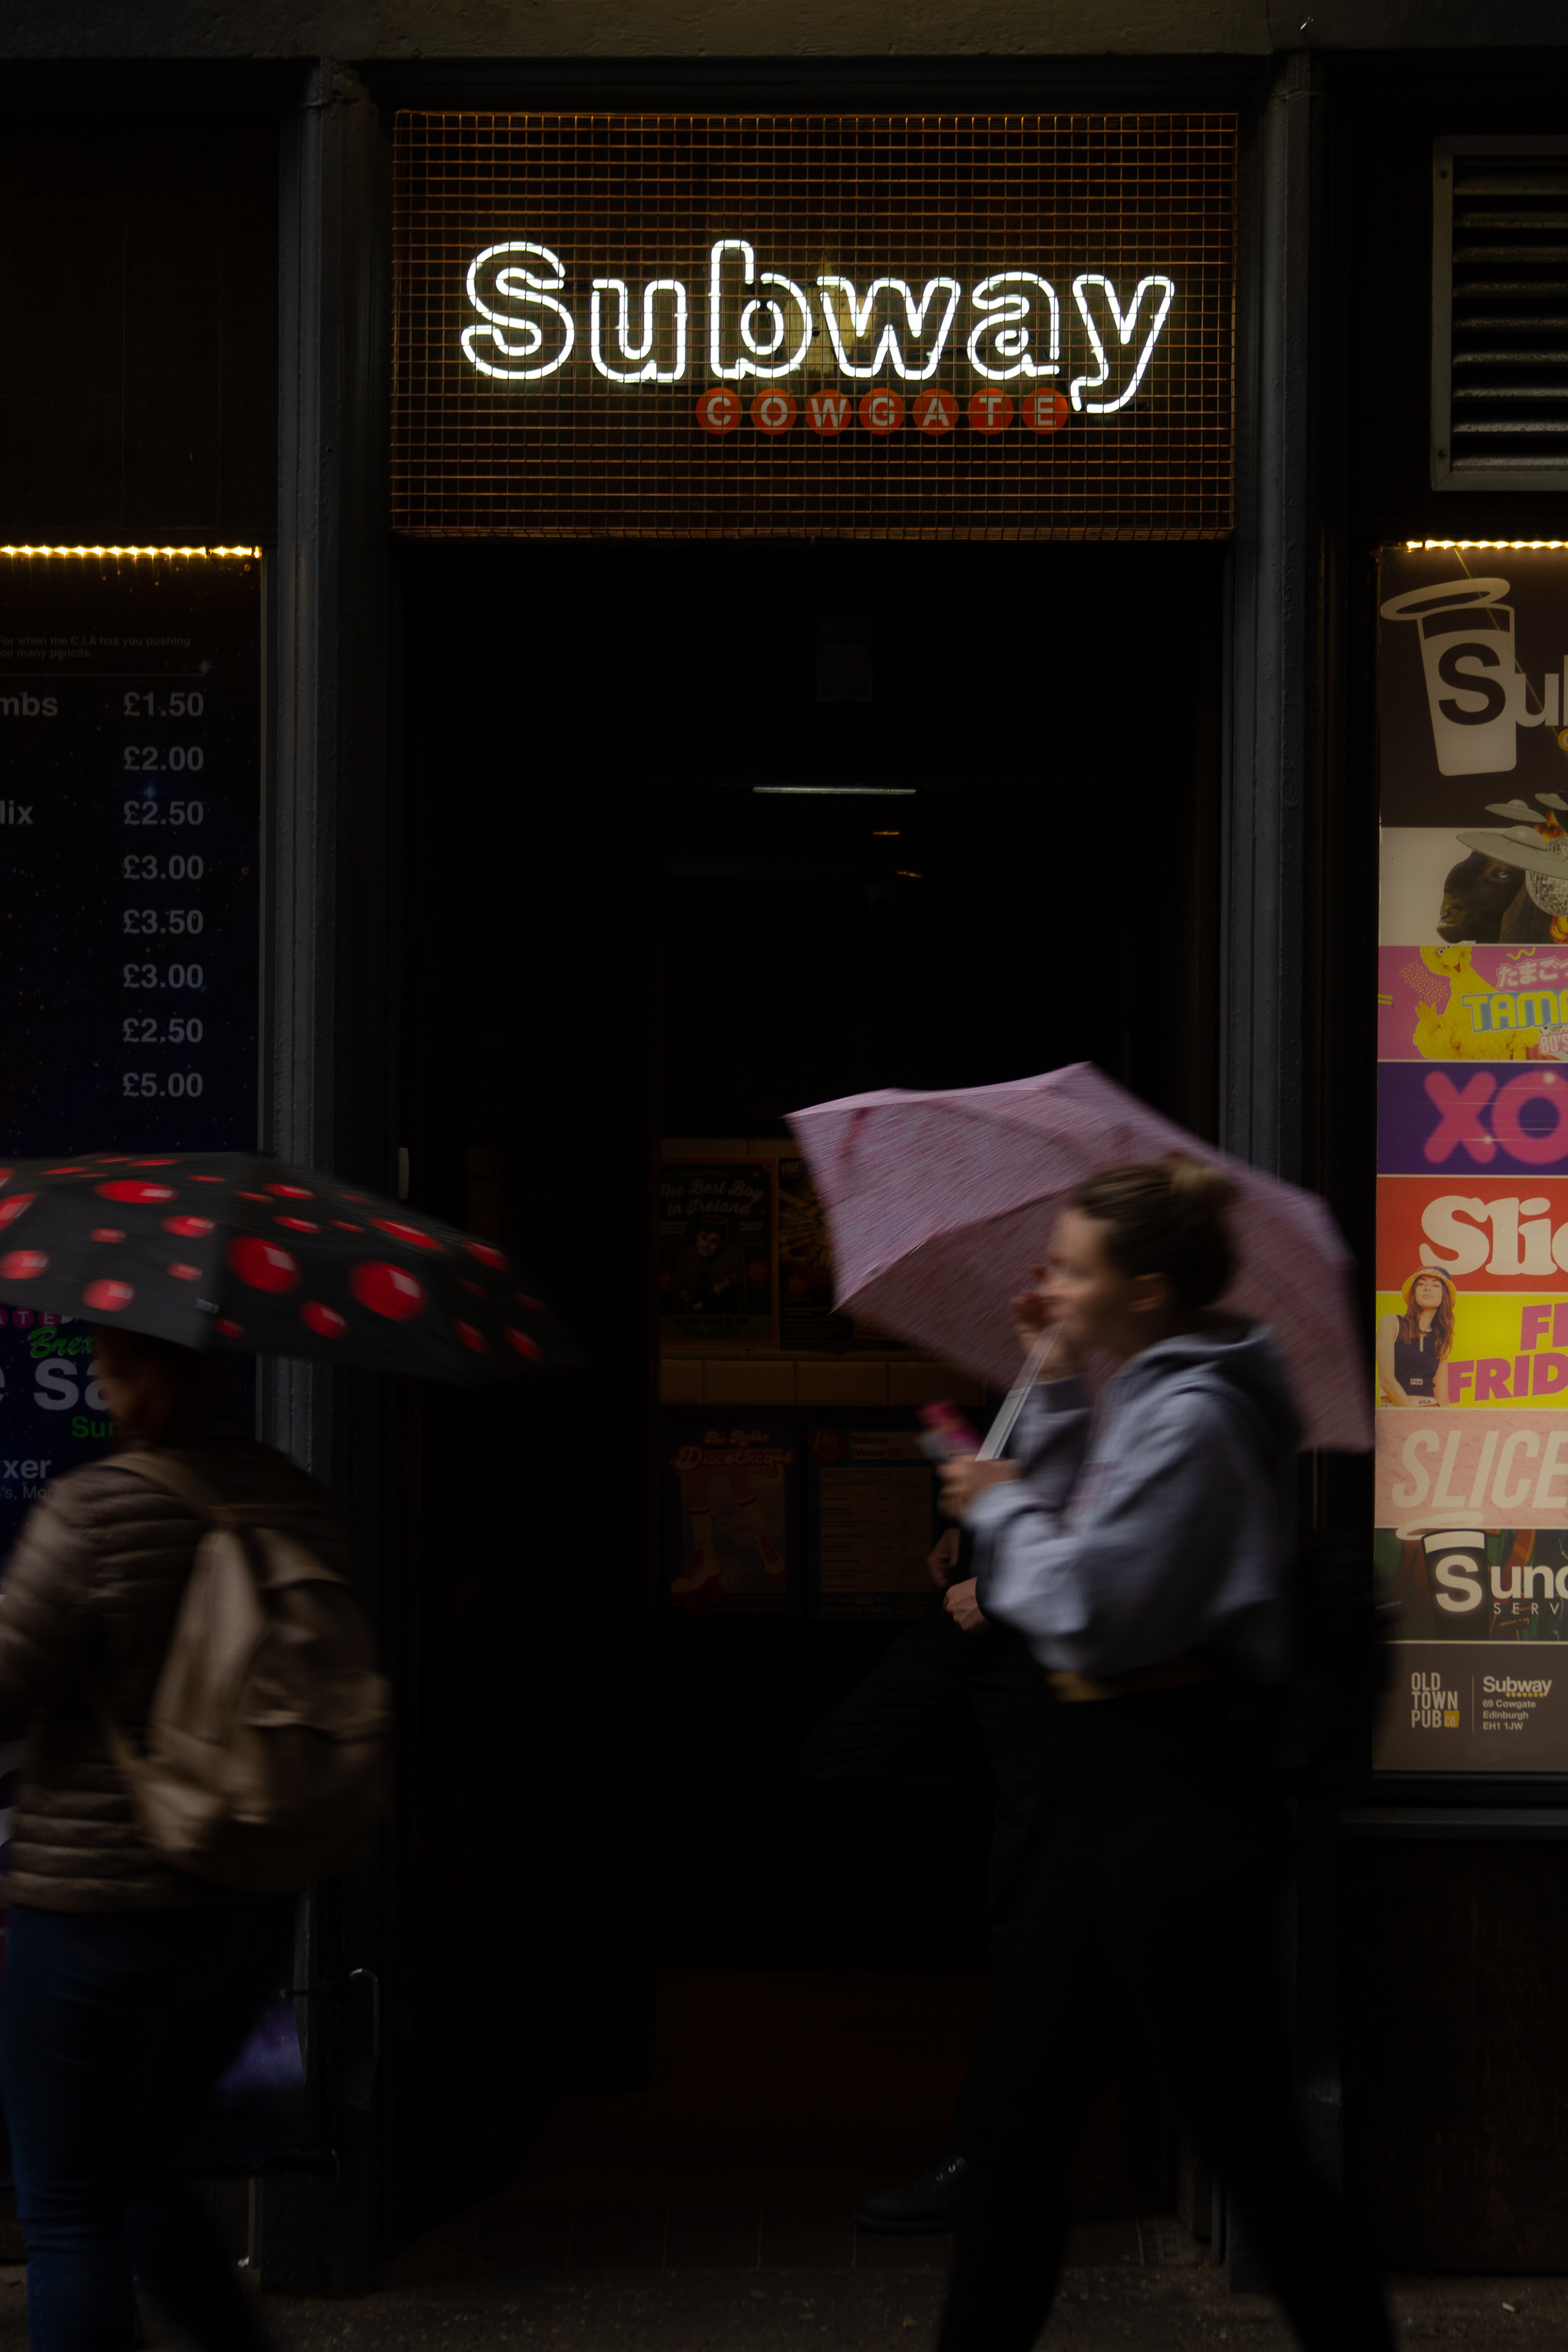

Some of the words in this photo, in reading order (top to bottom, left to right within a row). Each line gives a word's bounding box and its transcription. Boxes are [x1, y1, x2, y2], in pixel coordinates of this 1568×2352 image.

[461, 239, 1176, 413] Subway
[702, 393, 1057, 430] COWGATE
[18, 636, 47, 646] when
[50, 636, 67, 646] the
[99, 636, 119, 646] has
[122, 638, 142, 648] you
[146, 636, 191, 648] pushing
[17, 650, 47, 661] many
[1438, 643, 1568, 728] Su
[123, 691, 204, 717] £1.50
[123, 746, 204, 771] £2.00
[123, 800, 204, 826] £2.50
[123, 855, 204, 880] £3.00
[123, 909, 204, 935] £3.50
[122, 963, 204, 989] £3.00
[122, 1018, 203, 1043] £2.50
[122, 1072, 203, 1098] £5.00
[688, 1178, 726, 1194] Best
[728, 1180, 765, 1203] Boy
[667, 1202, 684, 1216] in
[686, 1198, 751, 1216] Ireland
[1411, 1672, 1440, 1690] OLD
[1483, 1676, 1552, 1697] Subway
[1411, 1691, 1458, 1710] TOWN
[1496, 1699, 1536, 1710] Cowgate
[1411, 1710, 1442, 1728] PUB
[1483, 1710, 1529, 1721] Edinburgh
